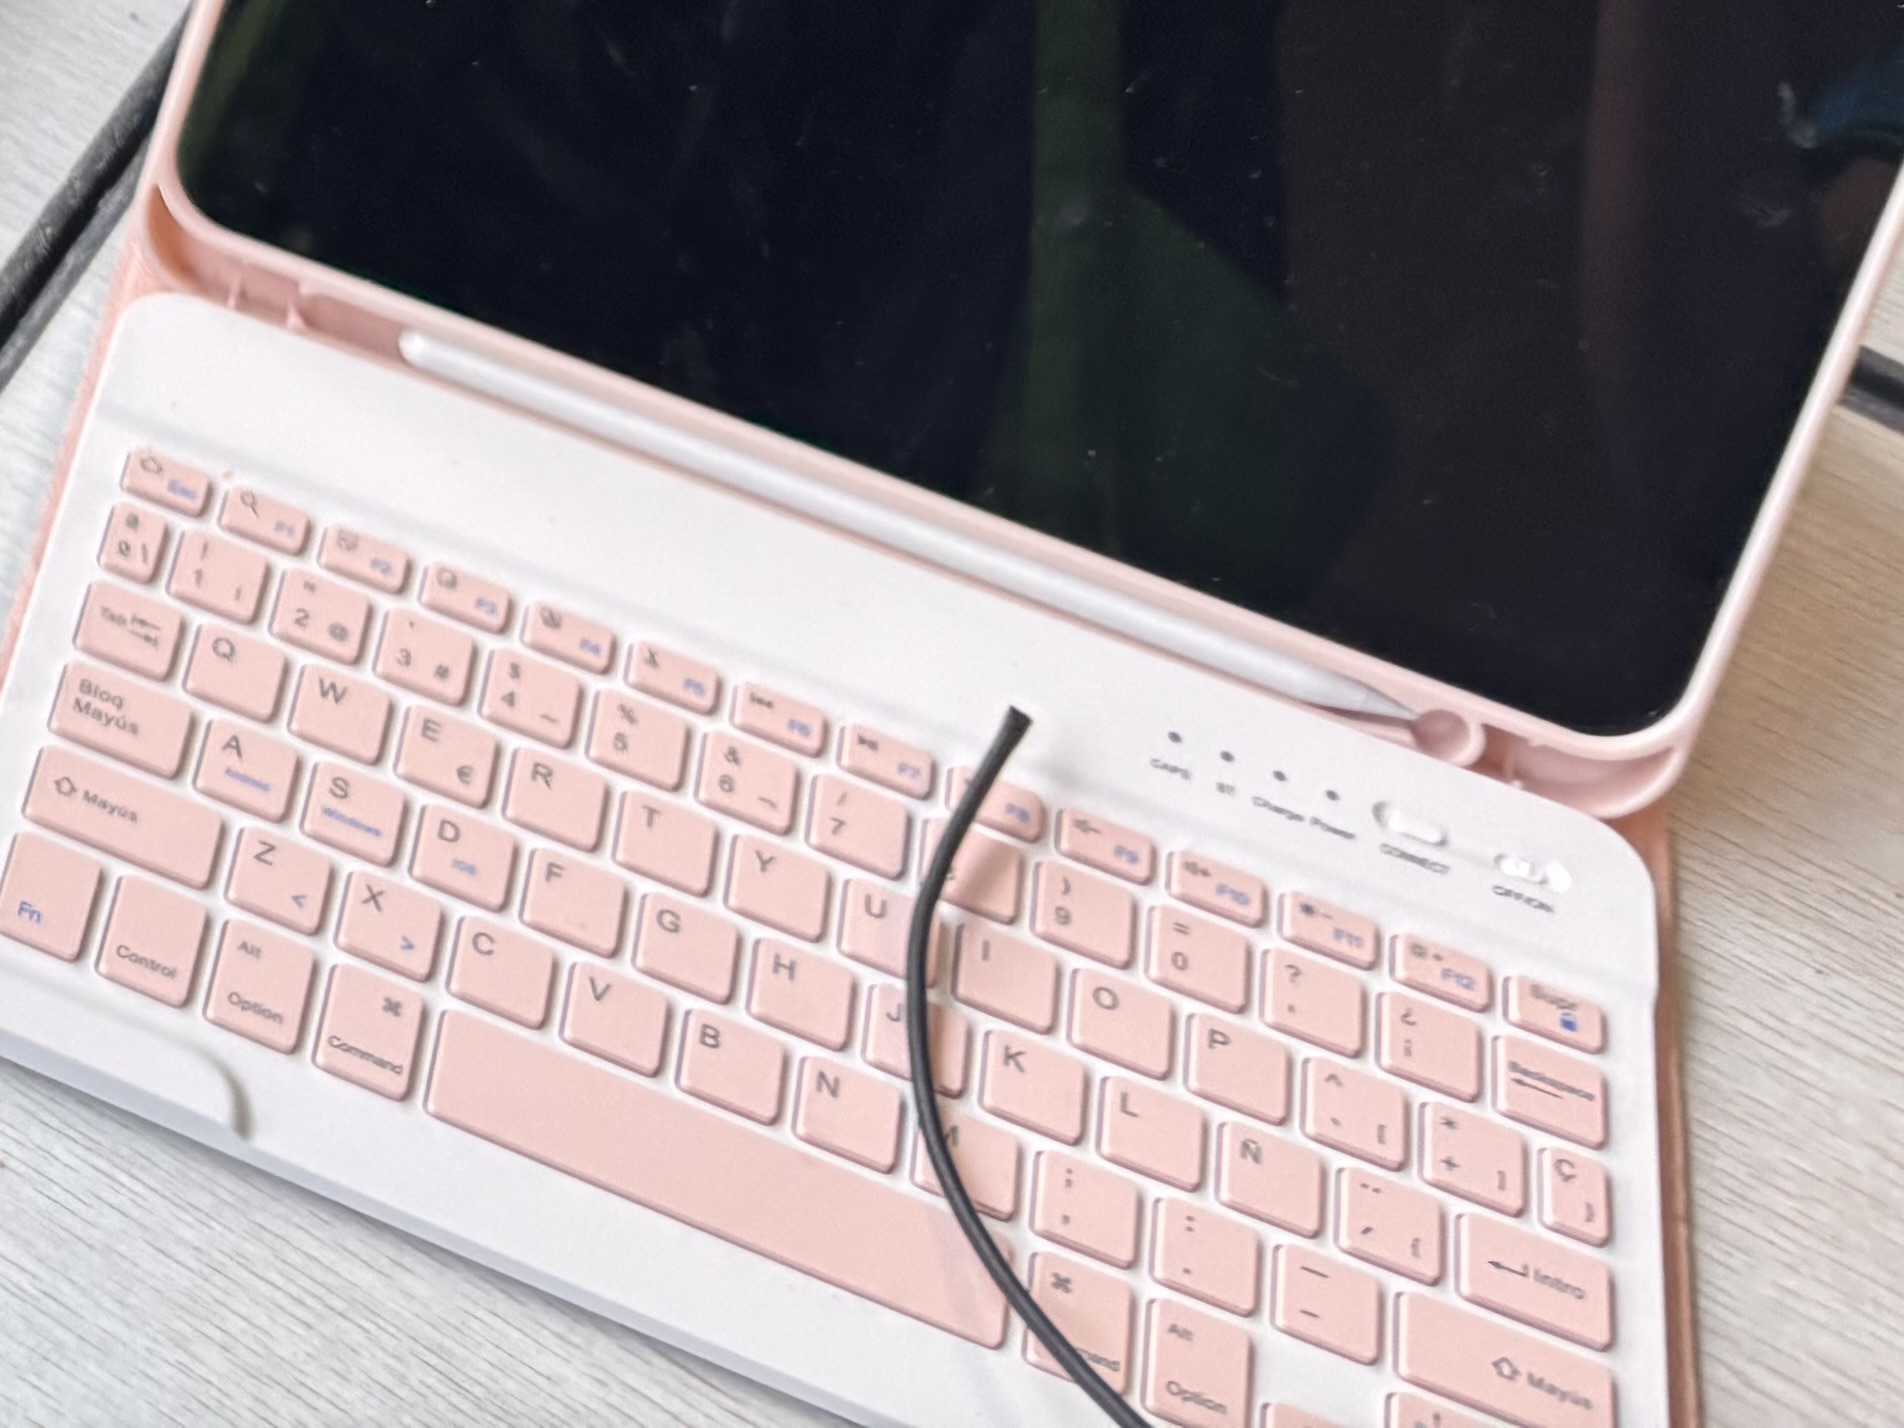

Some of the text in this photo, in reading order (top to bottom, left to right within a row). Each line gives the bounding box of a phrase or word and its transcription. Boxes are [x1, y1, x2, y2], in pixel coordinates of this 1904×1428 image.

[274, 520, 295, 537] F1
[370, 558, 393, 576] F2
[101, 606, 127, 627] Tab
[294, 608, 310, 628] 2
[328, 623, 349, 642] @
[212, 637, 236, 662] Q
[397, 648, 411, 667] 3
[510, 663, 520, 679] $
[77, 679, 124, 712] Bloq
[319, 678, 347, 704] W
[501, 691, 516, 707] 4
[71, 696, 139, 737] Mayús
[617, 704, 638, 725] %
[421, 718, 441, 742] E
[613, 732, 628, 752] 5
[222, 735, 242, 759] A
[725, 747, 740, 765] &
[457, 765, 473, 785] €
[531, 762, 553, 788] R
[897, 762, 922, 779] F7
[329, 777, 350, 800] S
[719, 775, 735, 793] 6
[83, 790, 138, 823] Mayús
[642, 805, 661, 829] T
[1252, 797, 1304, 822] Charge
[438, 819, 461, 843] D
[831, 817, 846, 836] 7
[1310, 817, 1355, 840] Power
[254, 841, 276, 866] Z
[755, 850, 776, 873] Y
[1114, 844, 1139, 864] F9
[545, 862, 564, 882] F
[361, 884, 384, 912] X
[865, 894, 888, 919] U
[1214, 883, 1250, 909] F10
[18, 901, 42, 923] Fn
[656, 909, 681, 934] G
[1055, 906, 1072, 926] 9
[238, 941, 262, 958] Alt
[472, 932, 495, 956] C
[114, 945, 177, 982] Control
[773, 953, 797, 981] H
[589, 976, 612, 1001] V
[1439, 968, 1477, 993] F12
[225, 992, 284, 1026] Option
[1092, 986, 1120, 1010] O
[886, 1003, 904, 1022] J
[699, 1024, 720, 1049] B
[1208, 1029, 1231, 1049] P
[326, 1035, 403, 1077] Command
[1003, 1045, 1025, 1072] K
[816, 1071, 840, 1098] N
[1120, 1092, 1139, 1118] L
[1241, 1139, 1262, 1164] Ñ
[1554, 1159, 1576, 1182] Ç
[1534, 1269, 1586, 1300] Intro
